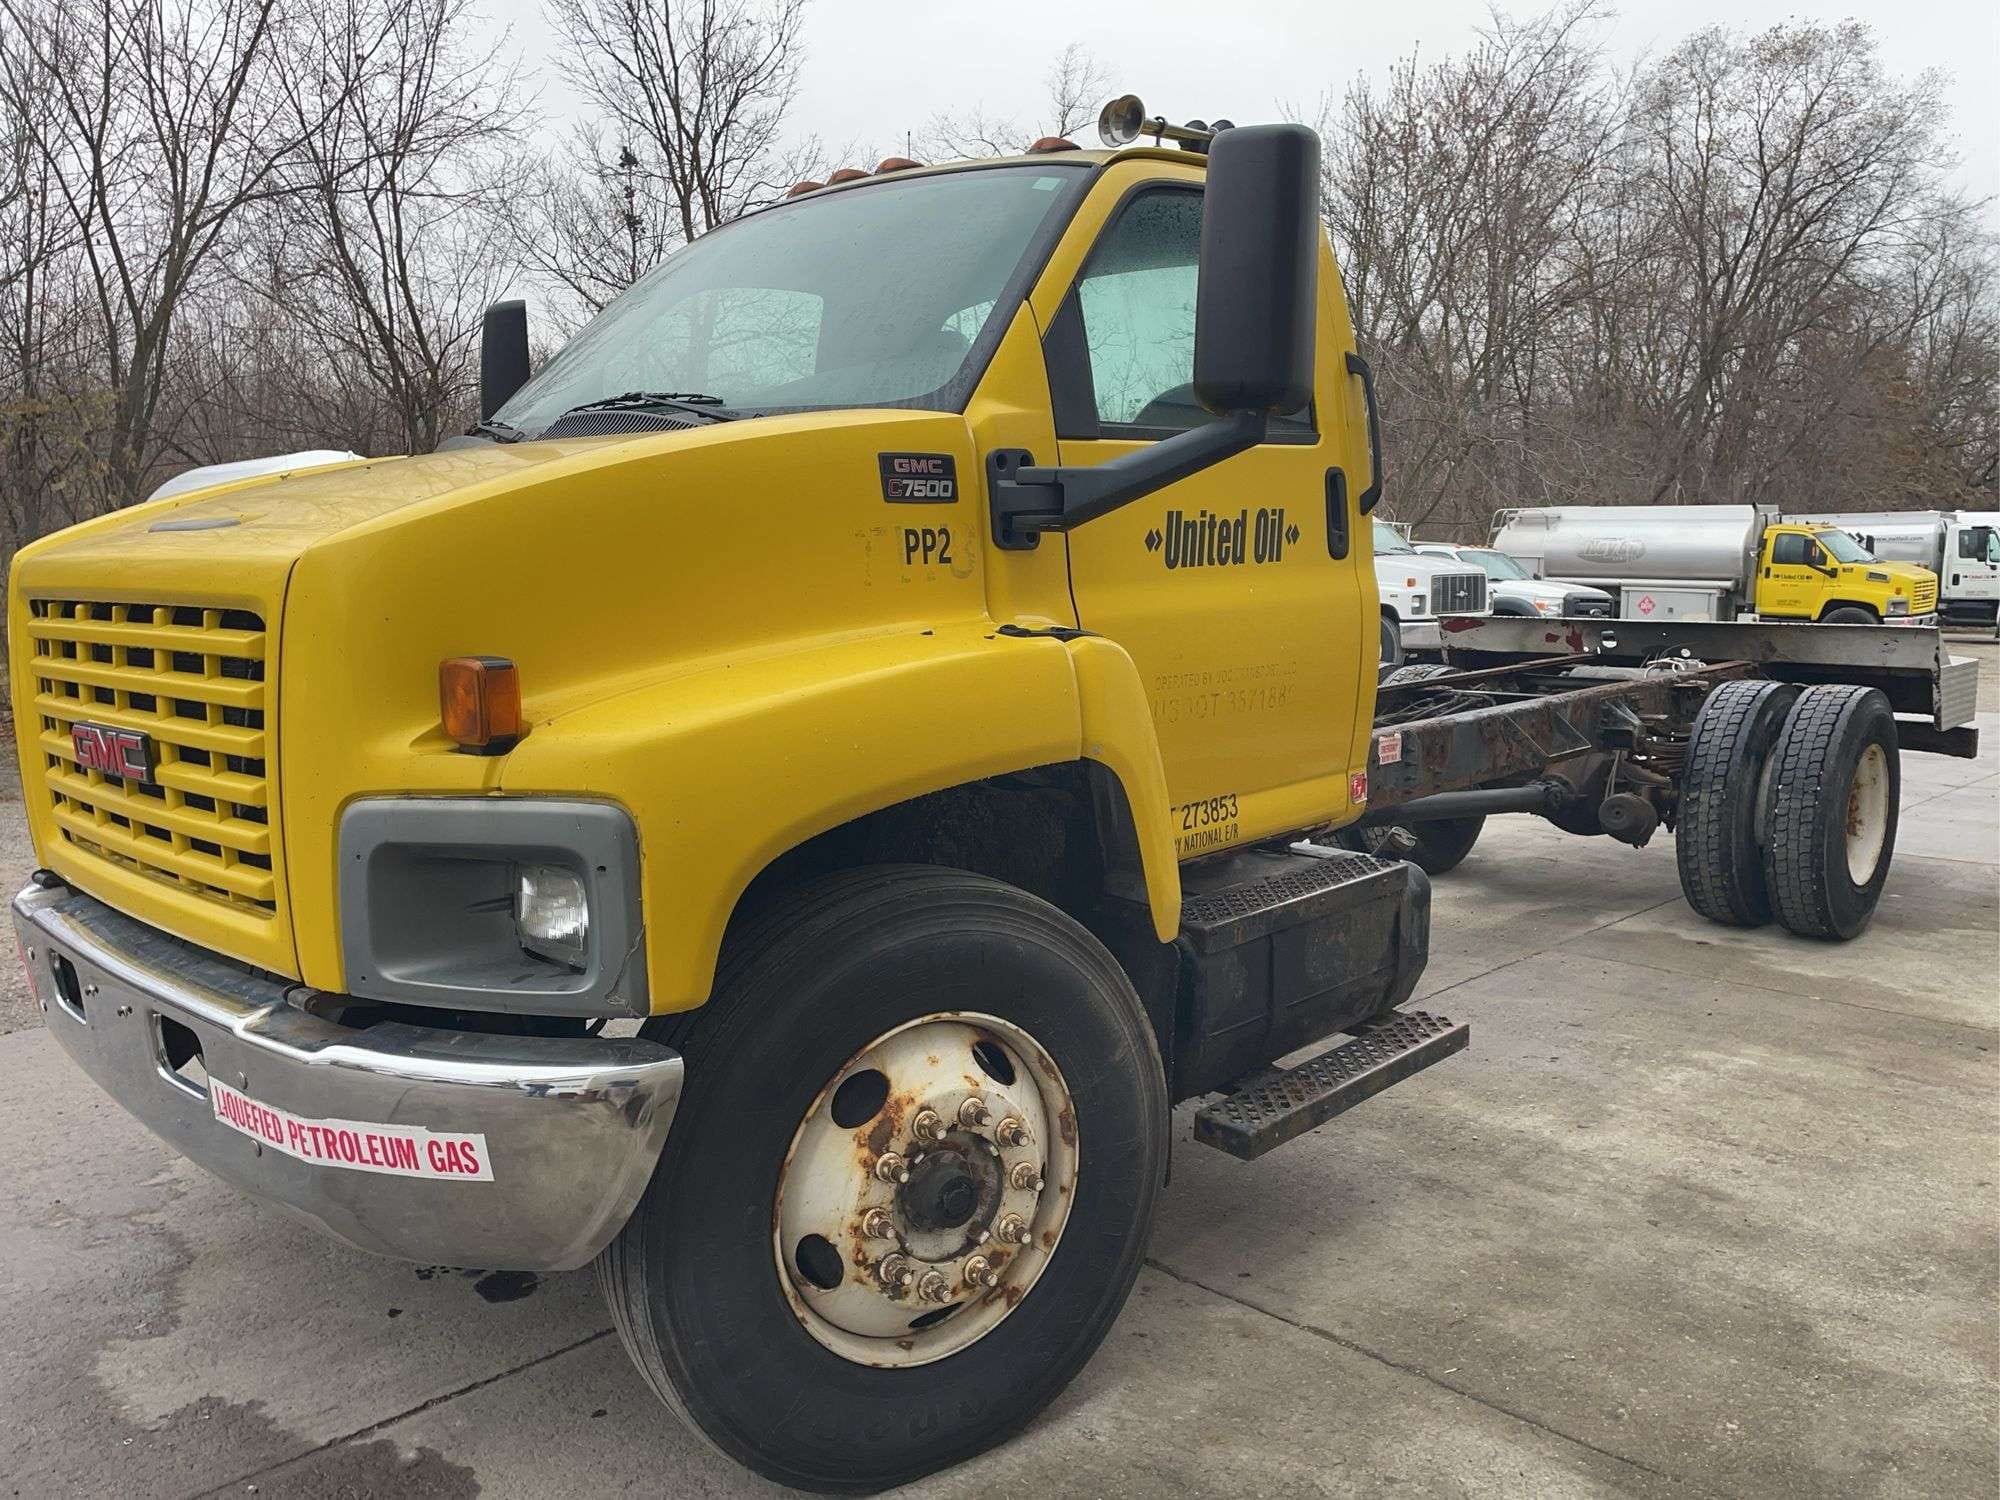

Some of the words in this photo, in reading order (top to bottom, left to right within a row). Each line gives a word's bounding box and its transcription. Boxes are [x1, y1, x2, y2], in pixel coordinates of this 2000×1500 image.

[893, 458, 944, 474] GMC
[888, 479, 953, 498] C7500
[904, 527, 952, 565] PP2
[1164, 510, 1248, 570] United
[1254, 508, 1285, 564] Oil
[71, 723, 148, 782] GMC
[1181, 793, 1238, 831] 273853
[1184, 827, 1223, 852] NATIONAL
[1225, 823, 1239, 841] E/R
[214, 1086, 284, 1145] LIQUEFIED
[287, 1119, 420, 1170] PETROLEUM
[427, 1140, 480, 1175] GAS
